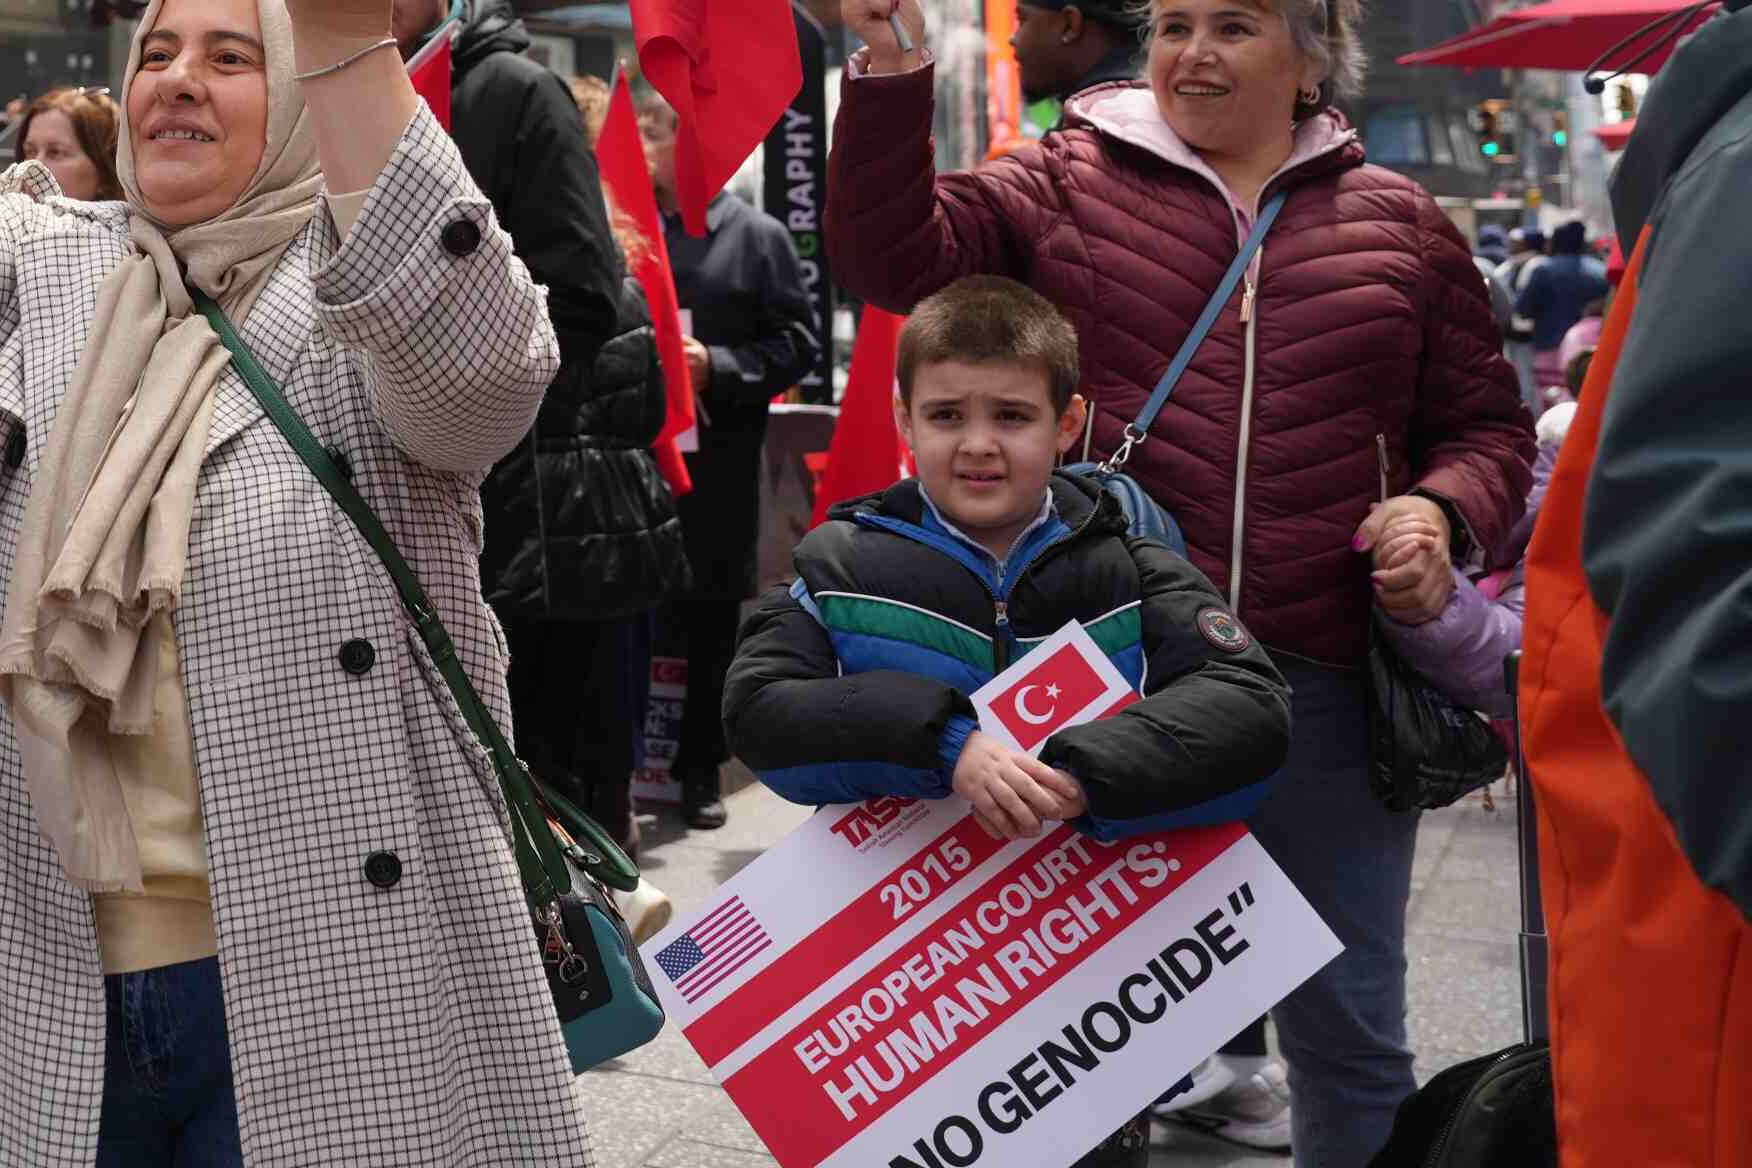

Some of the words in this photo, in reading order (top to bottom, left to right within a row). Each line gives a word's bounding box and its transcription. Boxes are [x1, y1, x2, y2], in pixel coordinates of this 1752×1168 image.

[793, 928, 985, 1076] EUROPEAN
[976, 832, 1093, 936] COURT
[822, 963, 1010, 1122] HUMAN
[1006, 841, 1182, 991] RIGHTS:
[879, 837, 972, 924] 2015
